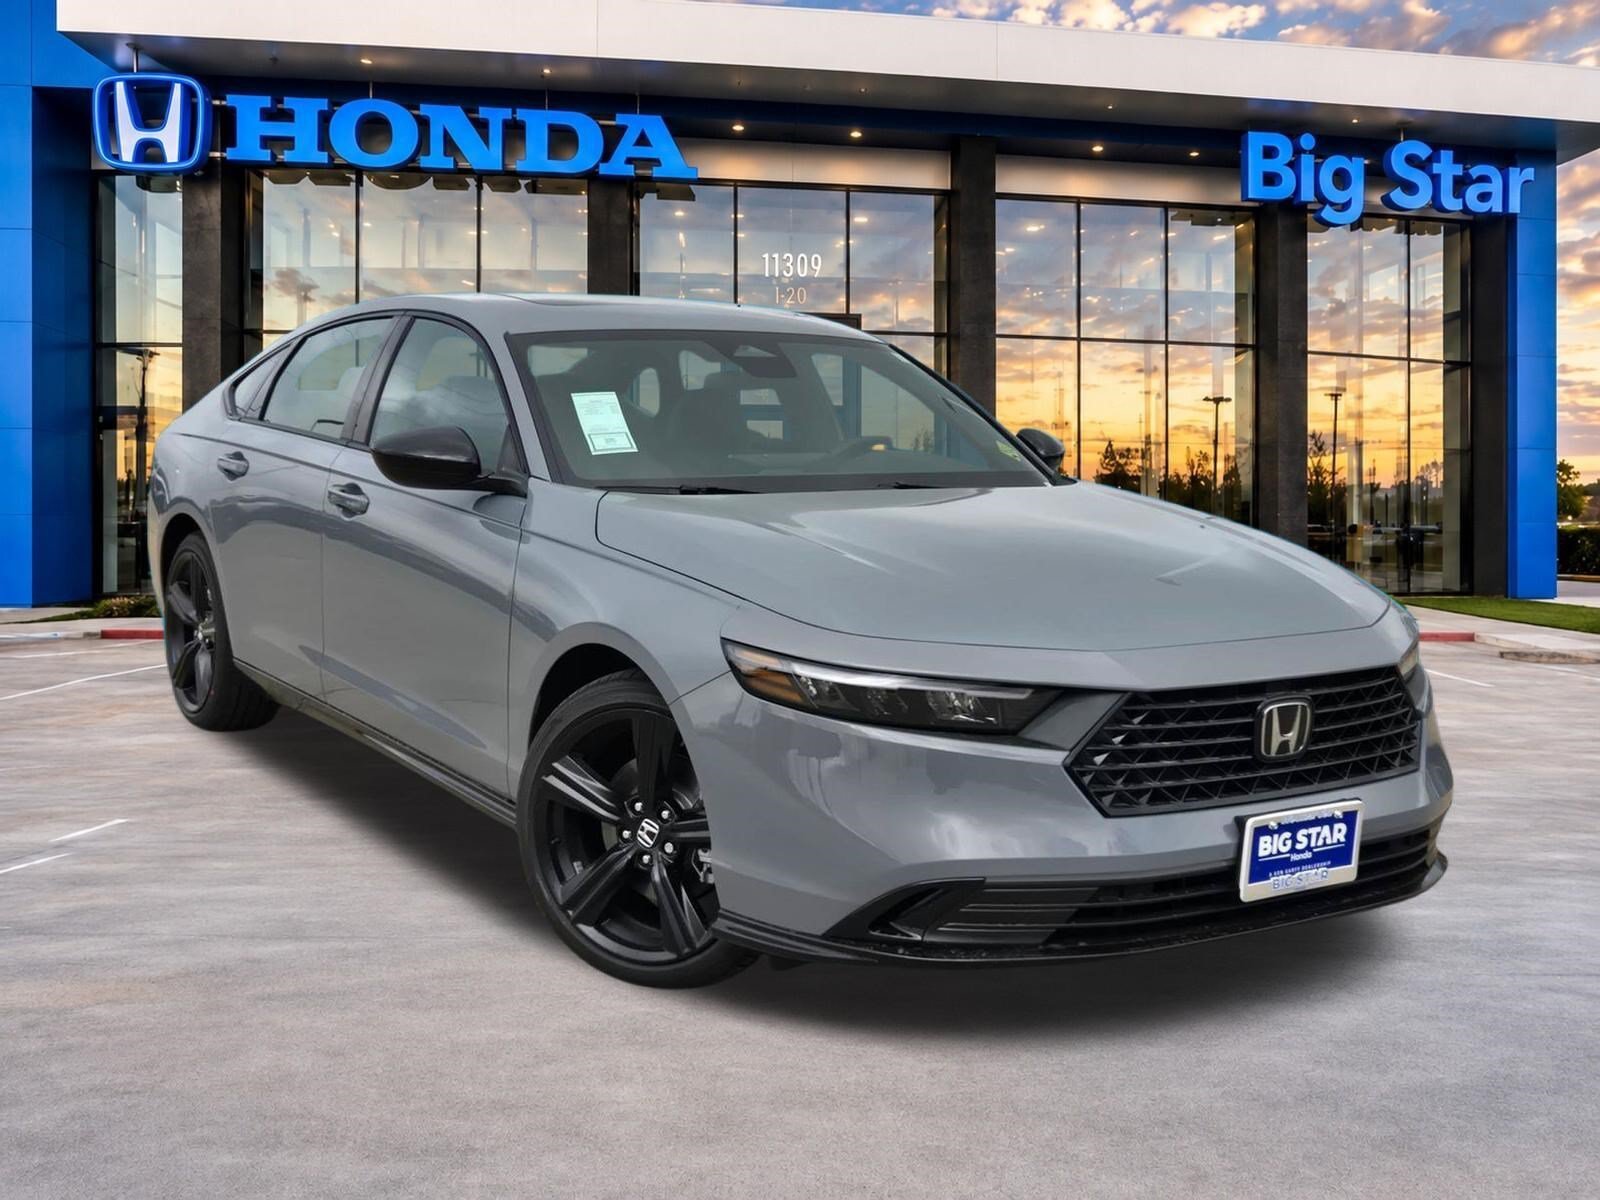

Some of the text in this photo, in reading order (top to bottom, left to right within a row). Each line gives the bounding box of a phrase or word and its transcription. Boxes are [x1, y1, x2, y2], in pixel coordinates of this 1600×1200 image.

[225, 94, 699, 180] HONDA
[1241, 131, 1535, 226] Big Star
[761, 252, 822, 278] 11309
[775, 286, 807, 304] I-20
[1257, 822, 1347, 857] BIG STAR
[1290, 850, 1312, 862] Honda
